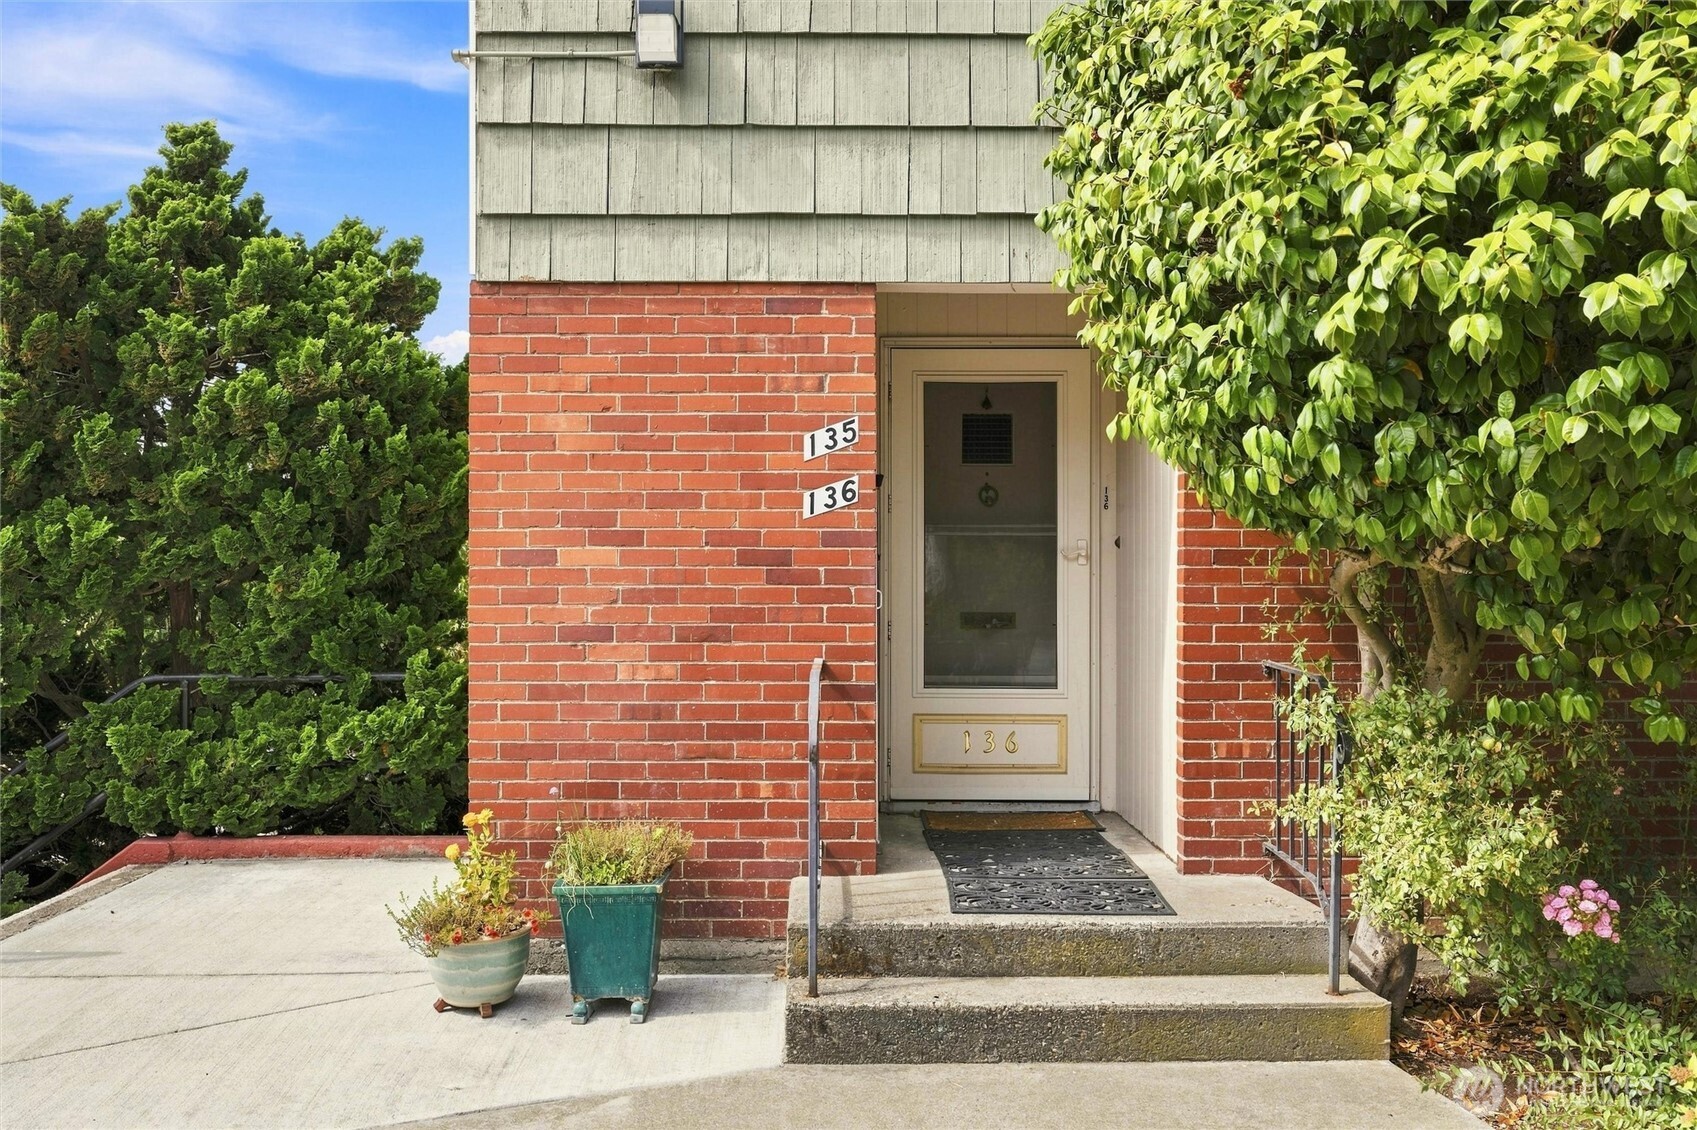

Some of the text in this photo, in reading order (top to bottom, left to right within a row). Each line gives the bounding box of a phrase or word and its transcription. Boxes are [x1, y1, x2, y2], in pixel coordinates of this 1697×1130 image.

[809, 419, 857, 457] 135
[809, 479, 857, 515] 136
[963, 730, 1018, 754] 136
